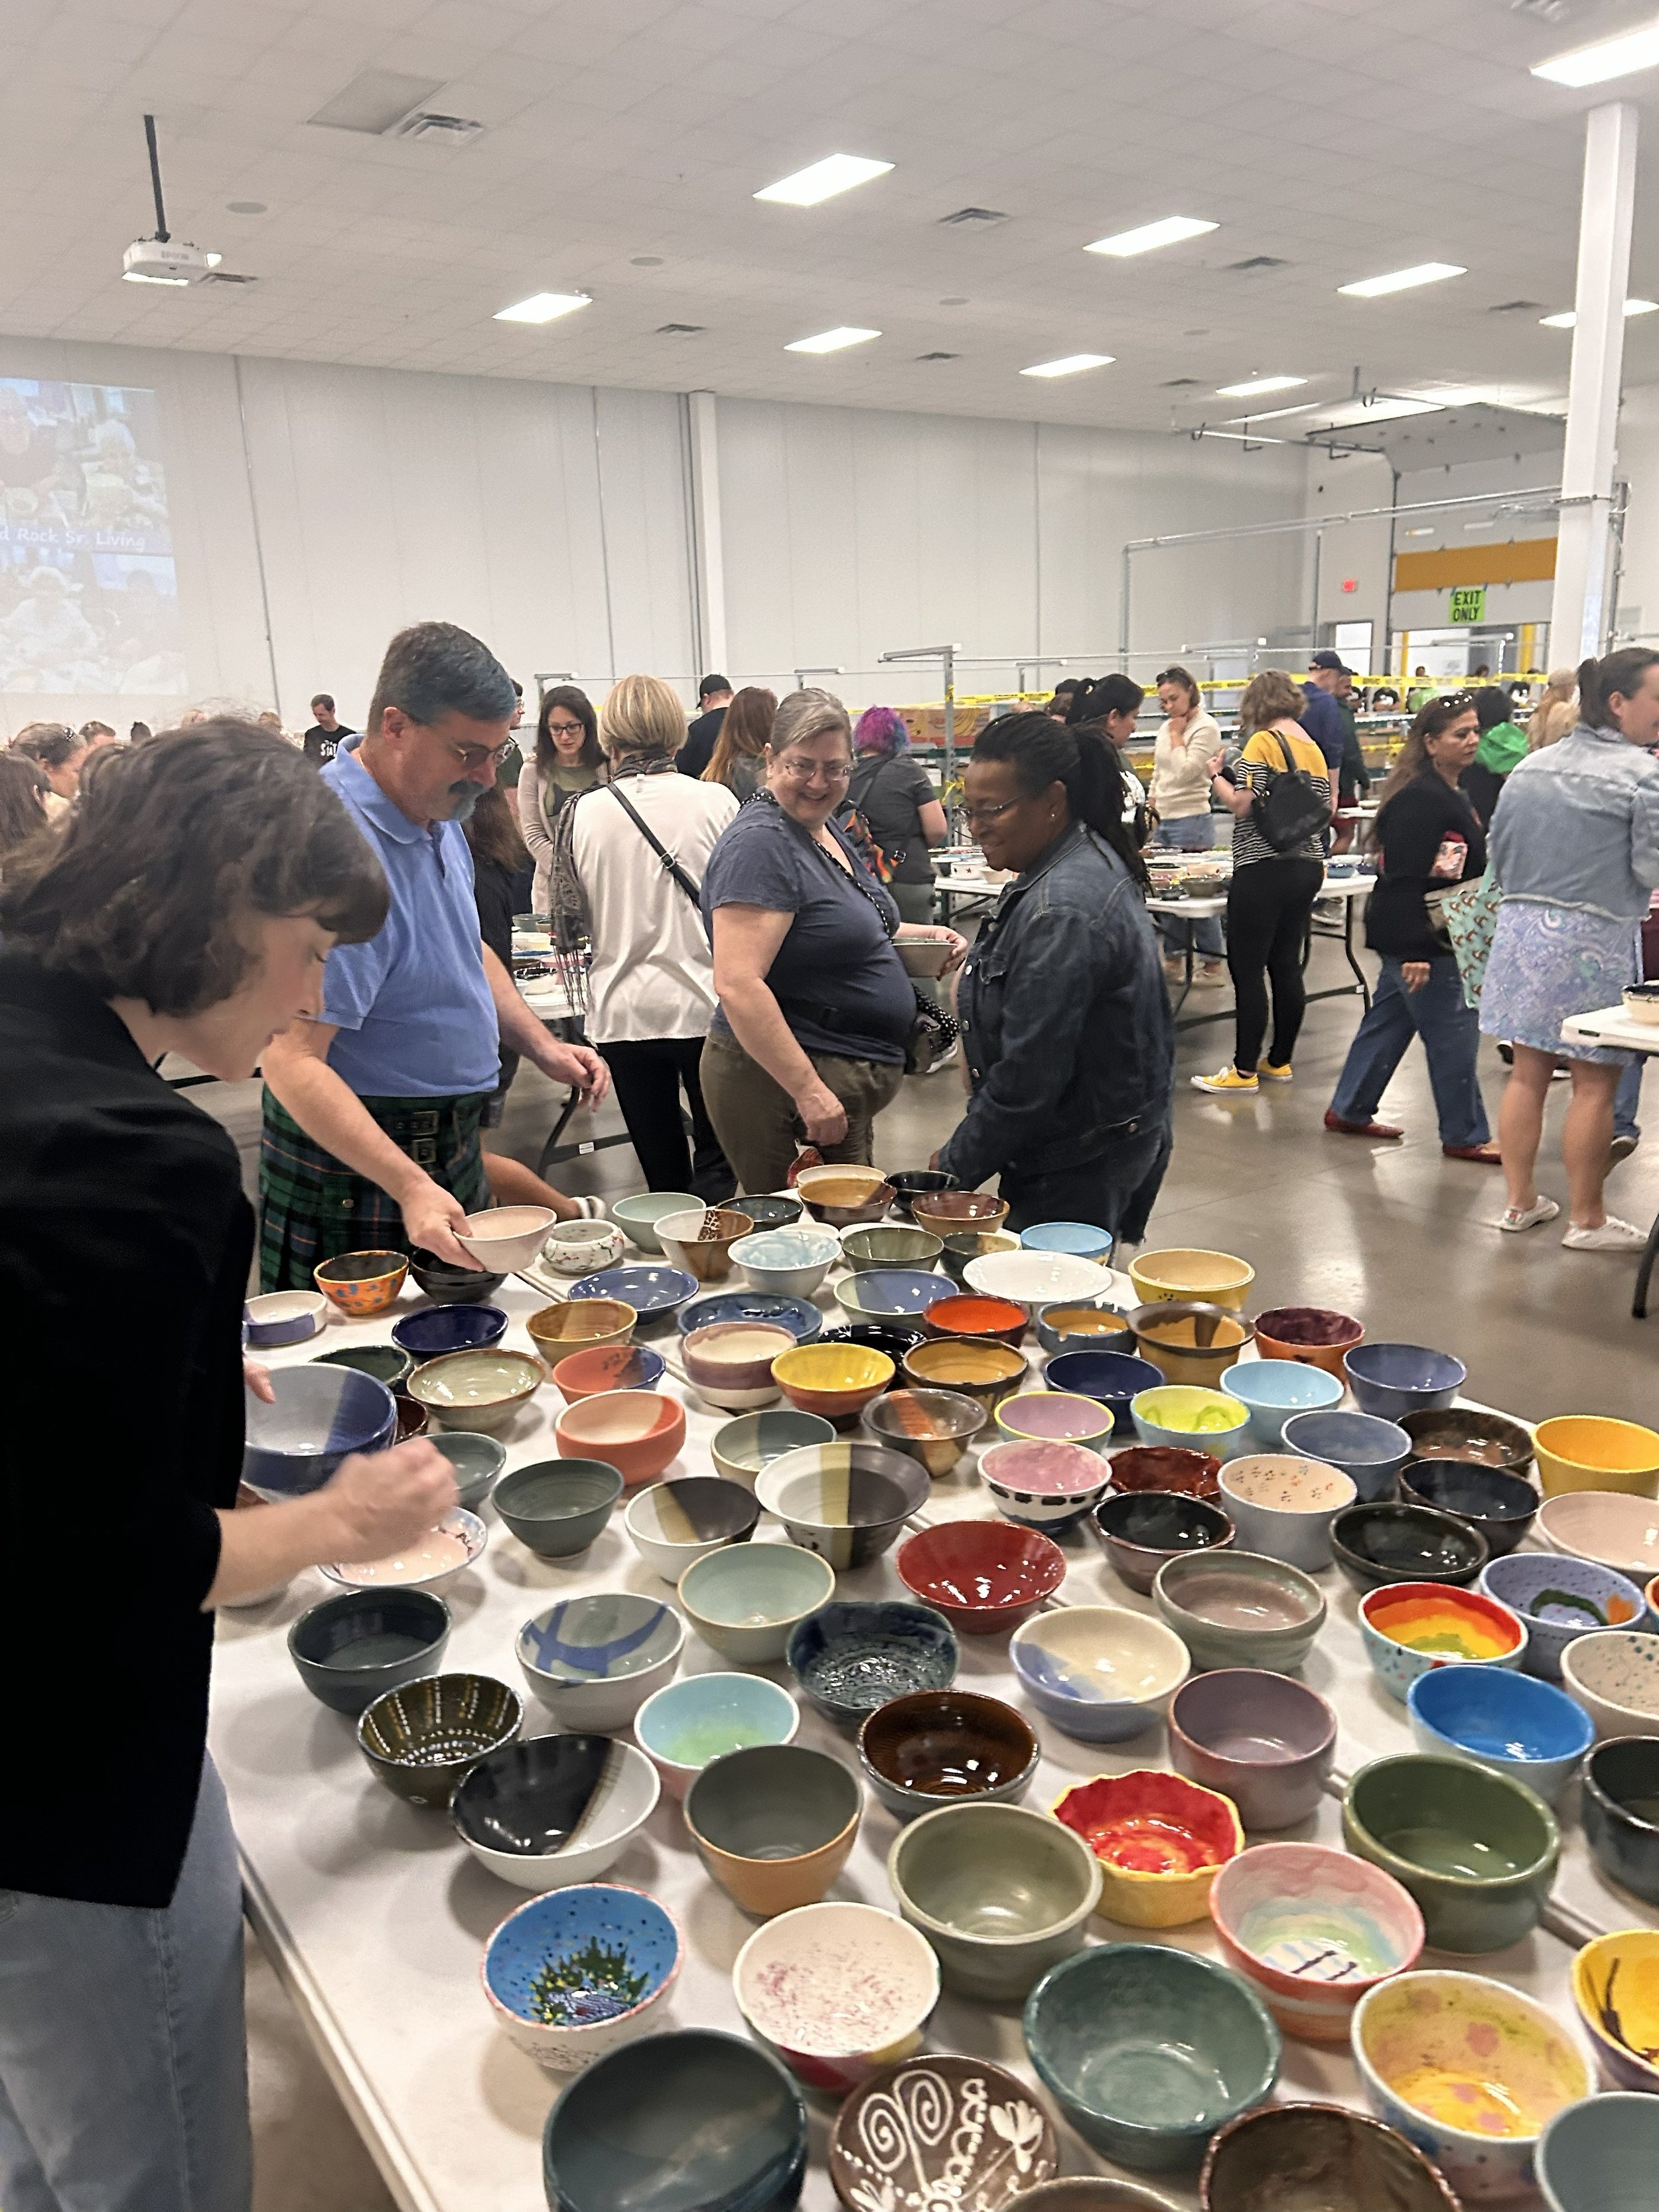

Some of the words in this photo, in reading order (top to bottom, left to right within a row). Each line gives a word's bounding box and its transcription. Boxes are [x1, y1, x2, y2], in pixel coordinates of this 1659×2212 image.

[17, 528, 58, 543] Rock
[96, 526, 145, 553] Living
[1455, 590, 1481, 605] EXIT
[1453, 607, 1480, 622] ONLY
